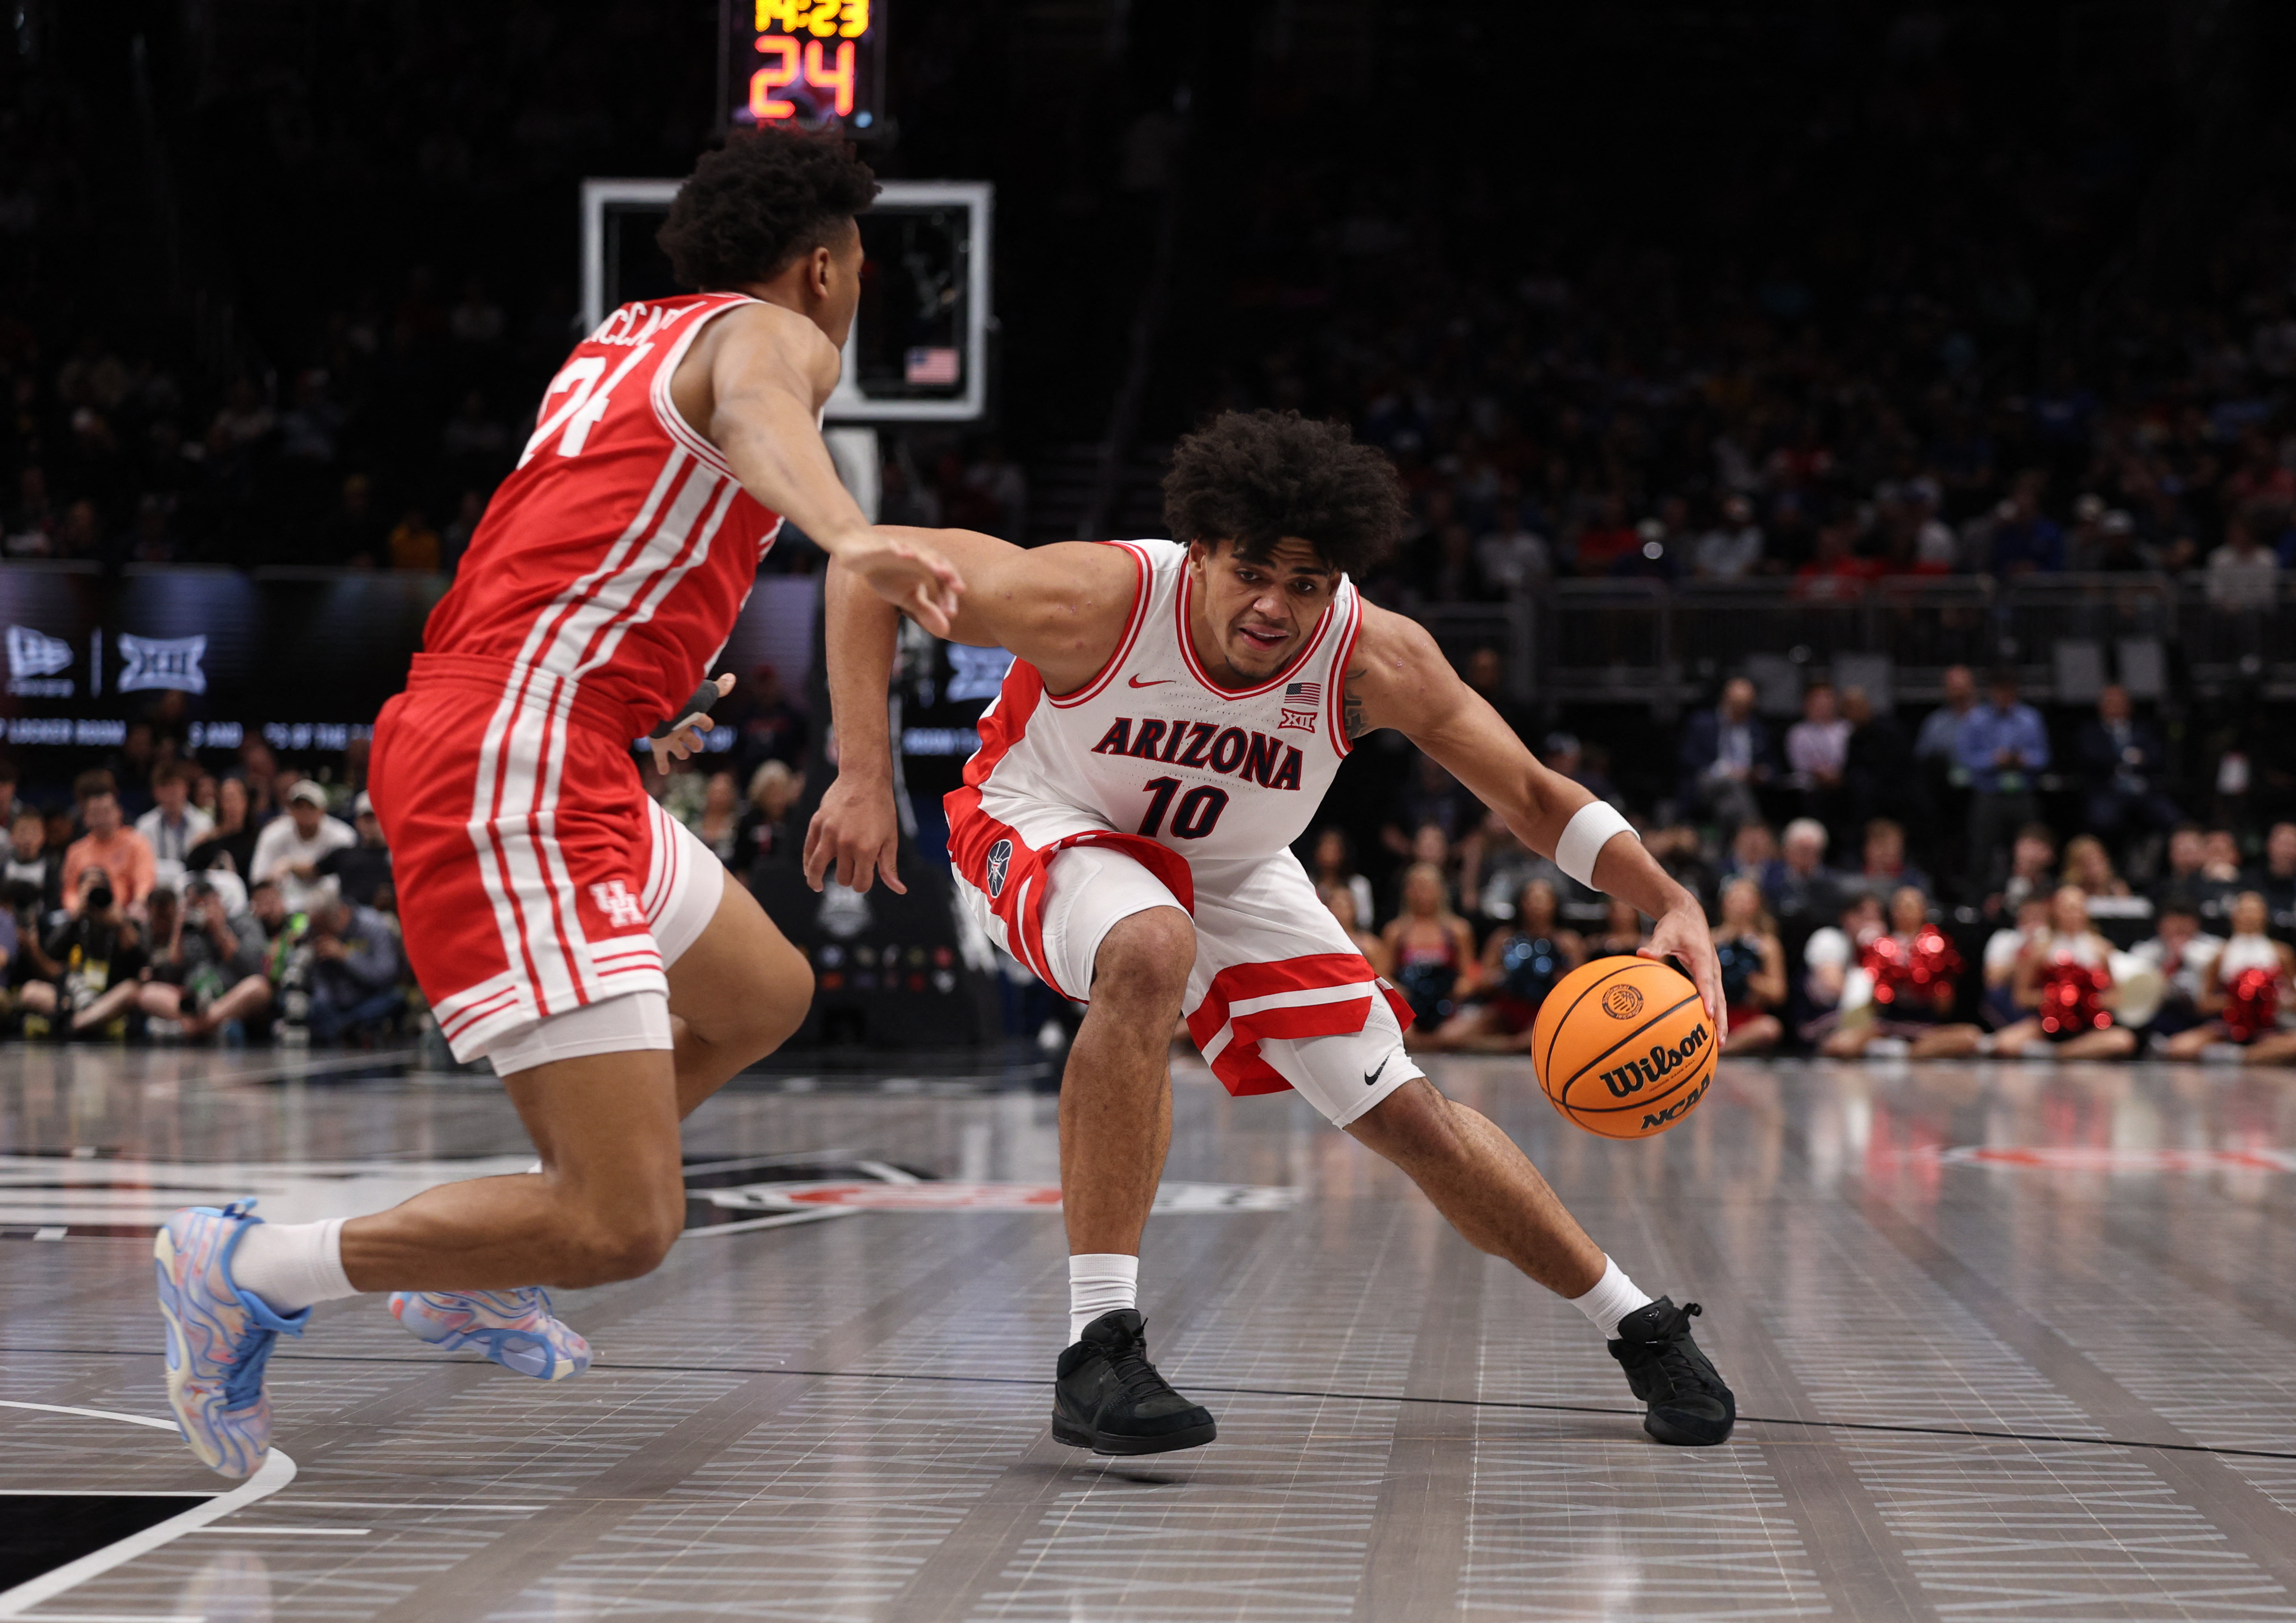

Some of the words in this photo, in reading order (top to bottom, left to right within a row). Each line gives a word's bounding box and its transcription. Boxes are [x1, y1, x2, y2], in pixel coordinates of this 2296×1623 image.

[750, 35, 855, 118] 24
[1091, 717, 1303, 791] ARIZONA
[1137, 776, 1229, 840] 10
[1599, 1022, 1708, 1098] Wilson
[1641, 1073, 1710, 1130] NCAA
